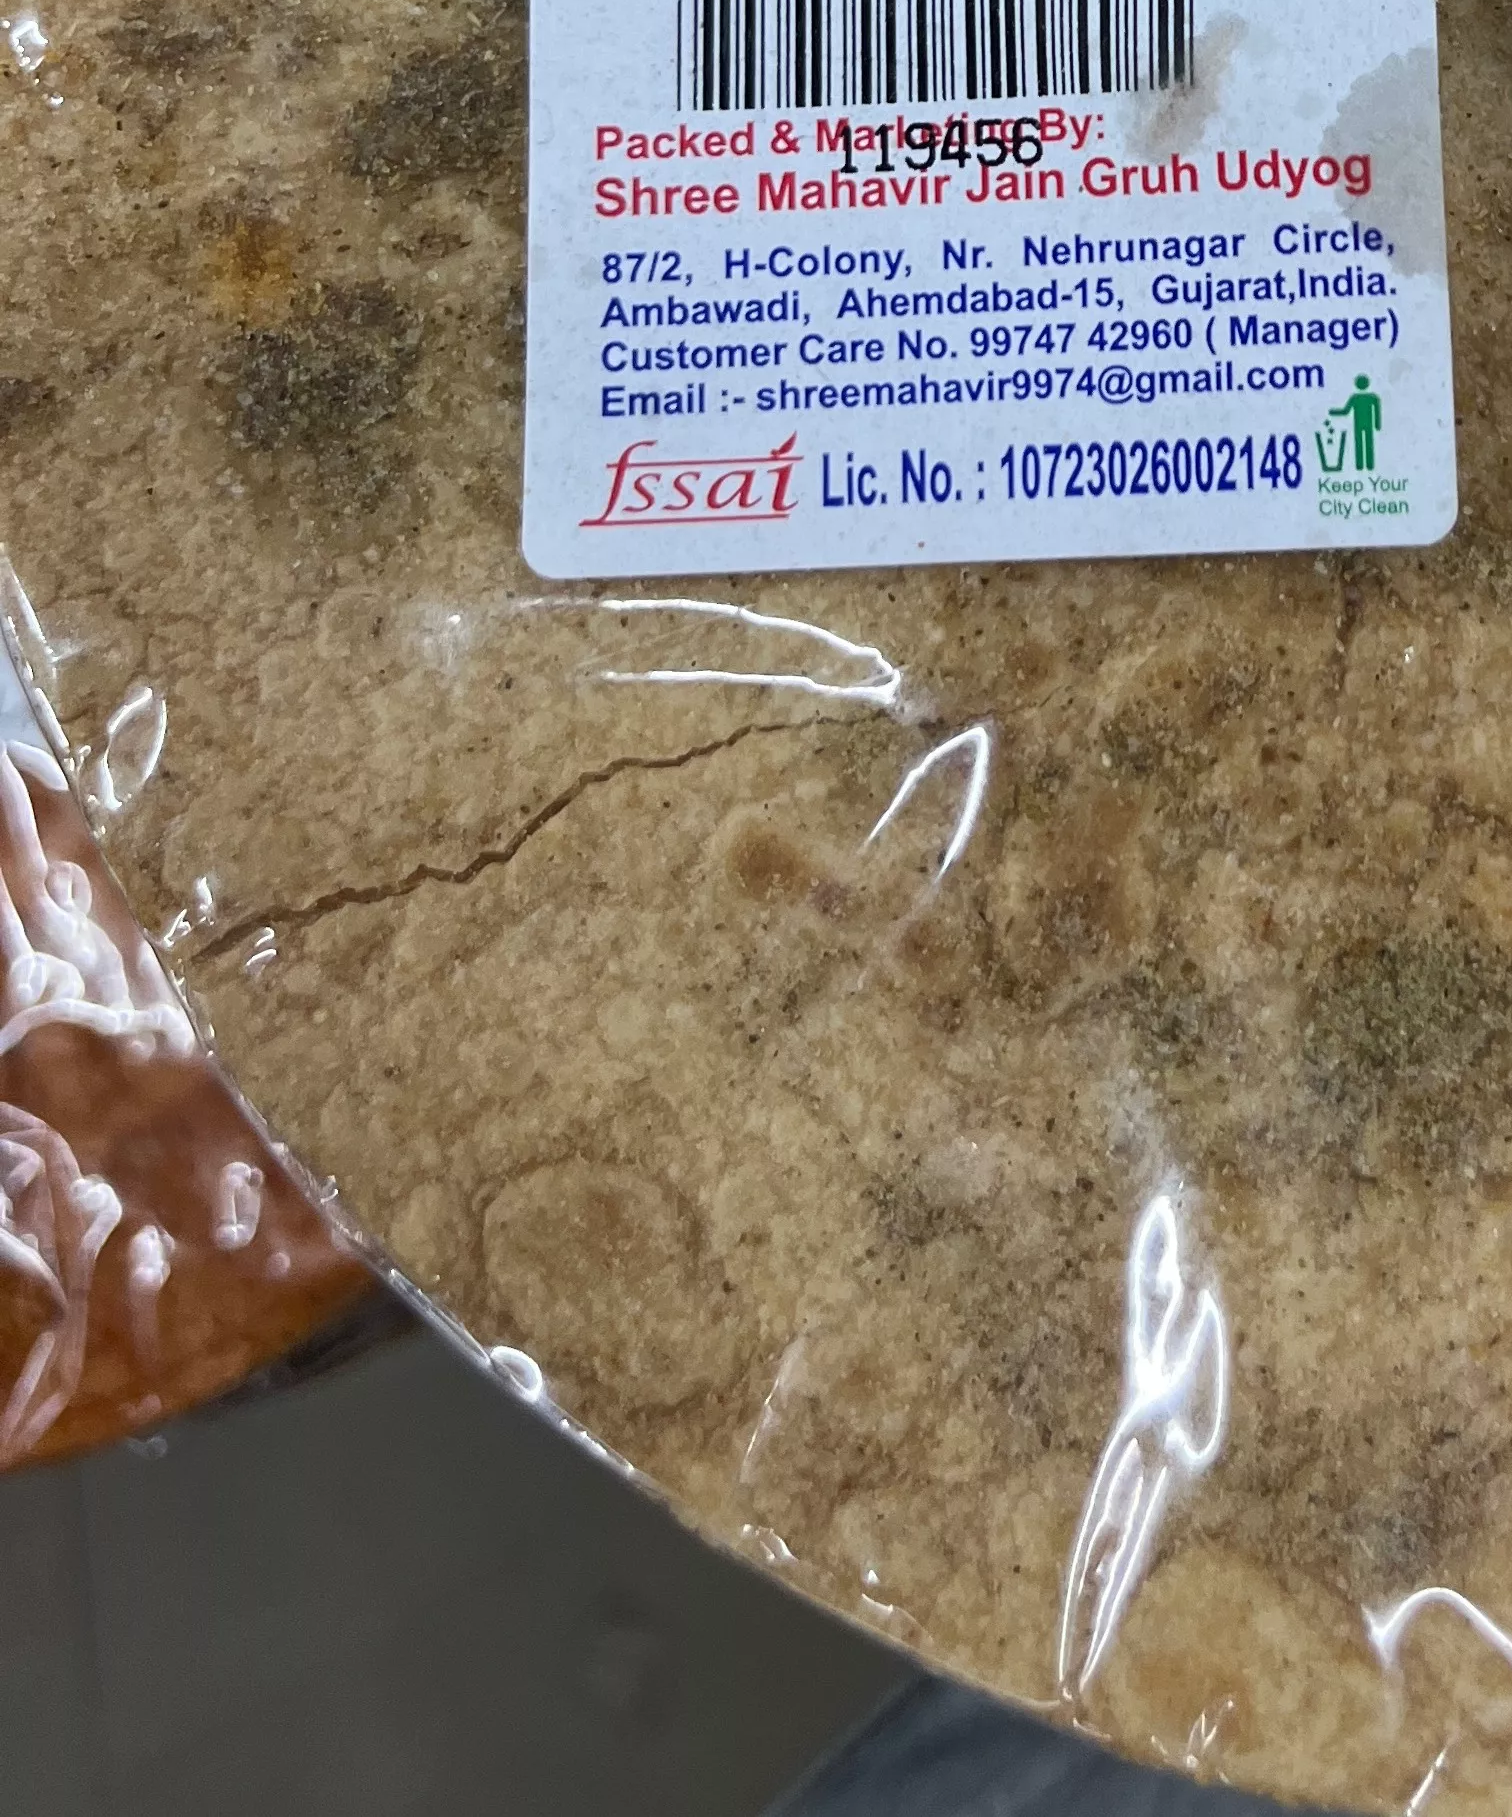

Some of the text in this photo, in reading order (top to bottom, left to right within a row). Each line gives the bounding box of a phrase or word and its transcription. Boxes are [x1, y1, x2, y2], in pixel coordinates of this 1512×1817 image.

[595, 123, 756, 160] Packed
[770, 119, 801, 156] &
[1038, 106, 1105, 151] By:
[839, 117, 1044, 173] 119456
[594, 148, 1373, 217] Shree Mahavir Jain Gruh Udyog
[602, 220, 1395, 288] 87/2, H-Colony, Nr. Nehrunagar Circle,
[600, 266, 1398, 328] Ambawadi, Ahemdabad-15, Gujarat,India.
[601, 340, 788, 373] Customer
[799, 333, 885, 365] Care
[898, 329, 958, 361] No.
[969, 324, 1076, 358] 99747
[1087, 318, 1193, 352] 42960
[1229, 308, 1400, 351] Manager)
[601, 360, 1326, 417] Email :- shreemahavir9974@gmail.com
[578, 431, 804, 527] fssai
[821, 433, 1302, 508] Lic. No. : 10723026002148
[1318, 475, 1409, 497] Keep Your
[1318, 497, 1409, 519] City Clean
